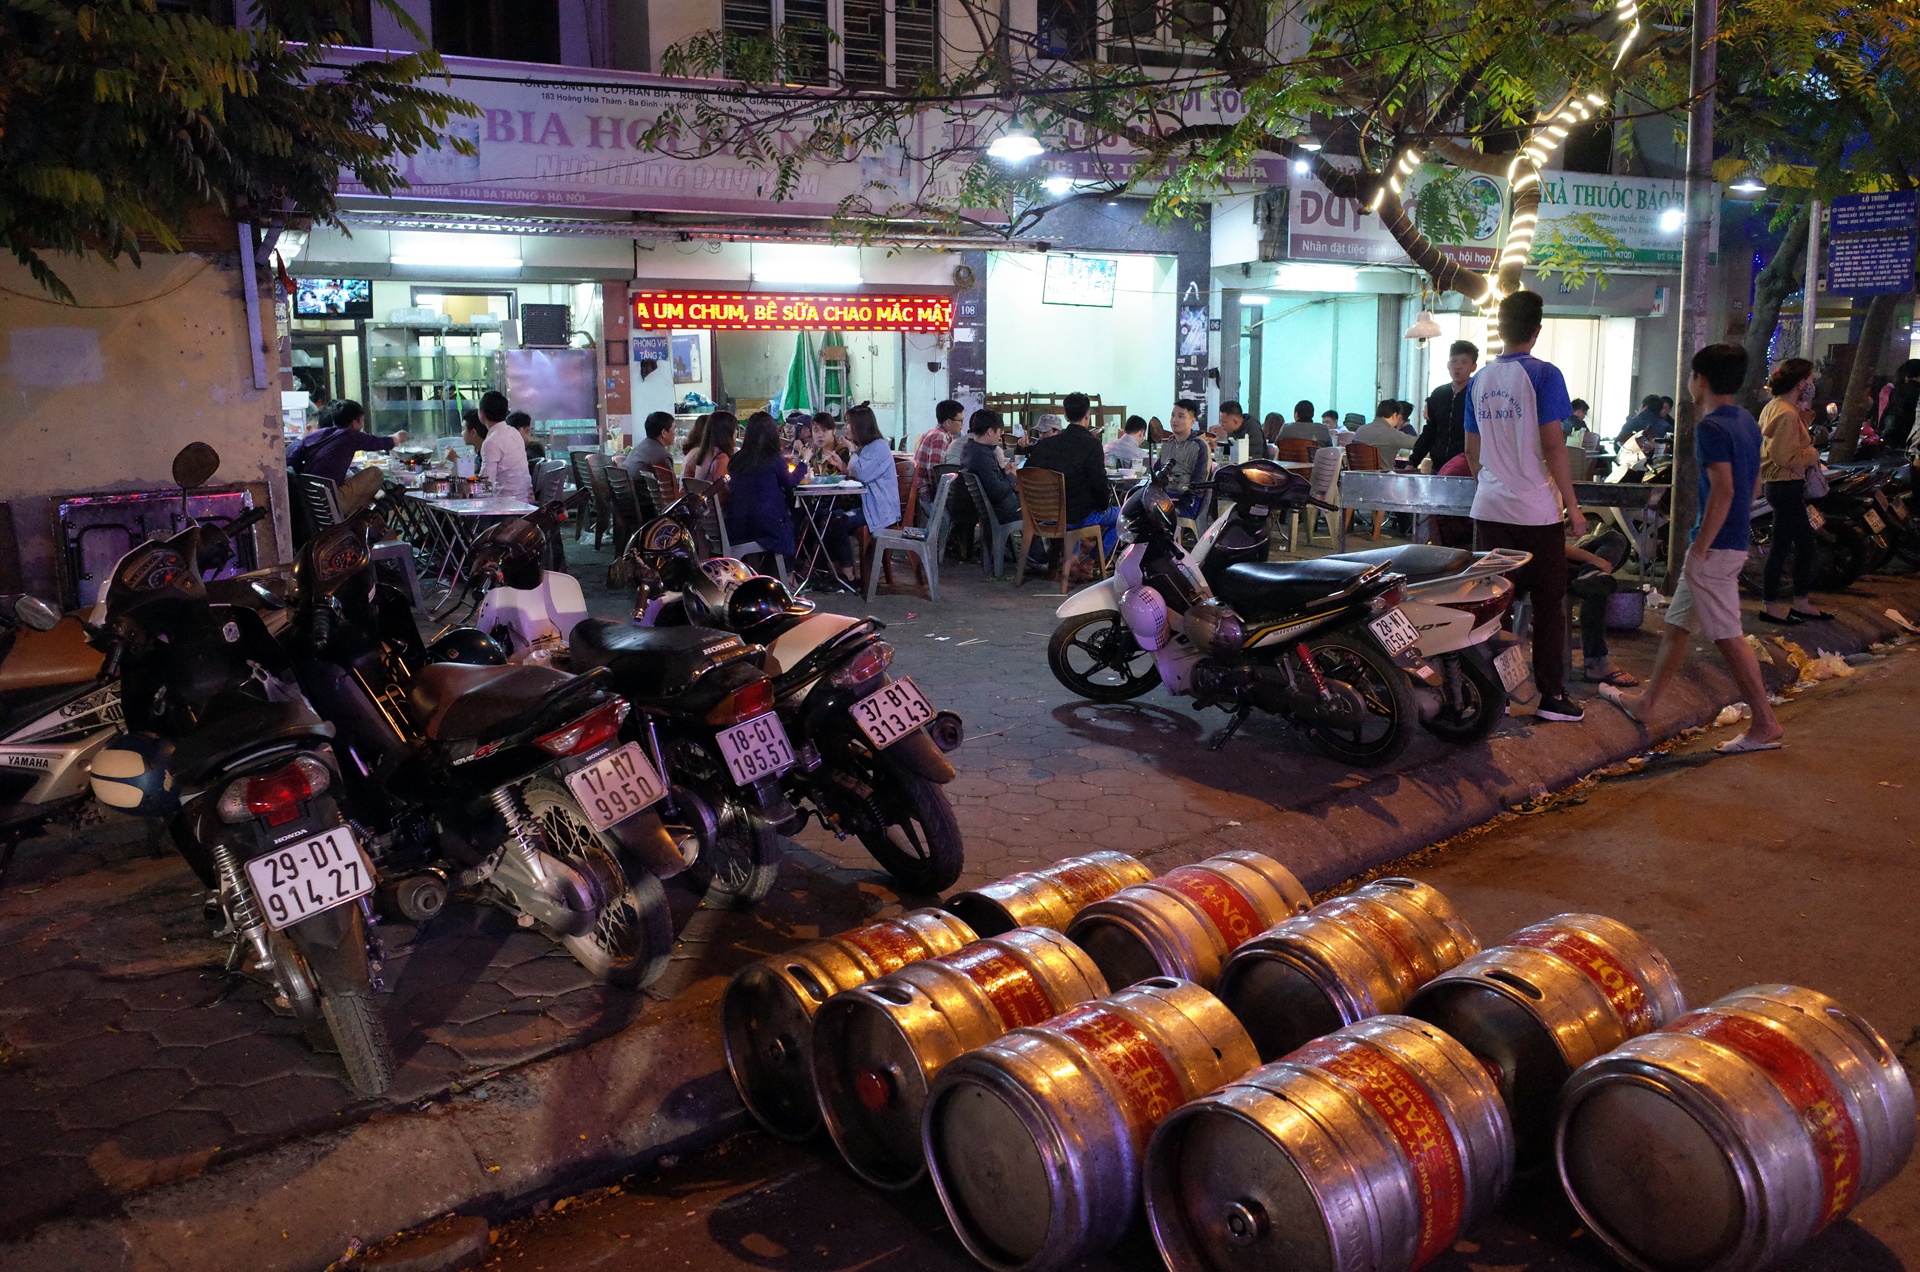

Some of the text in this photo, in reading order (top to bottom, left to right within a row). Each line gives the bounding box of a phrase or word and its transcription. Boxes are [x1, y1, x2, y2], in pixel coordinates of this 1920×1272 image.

[557, 94, 582, 103] Hoàng
[654, 89, 671, 98] BIA
[483, 107, 574, 148] BIA
[535, 154, 597, 184] NHÀ
[607, 157, 686, 188] HÀNG
[460, 188, 481, 198] HAI
[1573, 180, 1633, 209] THUỐC
[1302, 240, 1328, 252] Nhân
[1330, 242, 1345, 254] đặt
[1347, 243, 1365, 257] tiệc
[1367, 244, 1387, 255] sinh
[1459, 251, 1473, 264] hội
[653, 303, 684, 319] UM
[689, 303, 748, 322] CHUM,
[754, 300, 778, 320] BÊ
[823, 305, 872, 321] CHAO
[876, 302, 913, 322] MẮC
[917, 303, 951, 326] MẬT
[961, 305, 975, 315] 108
[703, 639, 738, 656] HONDA
[1384, 624, 1419, 652] 059.41
[859, 683, 912, 724] 37-B1
[868, 698, 931, 745] 313.43
[728, 719, 777, 754] 18-G1
[8, 755, 49, 768] YAMAHA
[585, 747, 609, 762] HONDA
[733, 738, 792, 781] 195.51
[579, 751, 640, 797] 17-M7
[594, 775, 656, 823] 9950
[273, 827, 309, 845] HONDA
[263, 834, 344, 890] 29-D1
[268, 862, 362, 922] 914.27
[1406, 1140, 1420, 1160] TY
